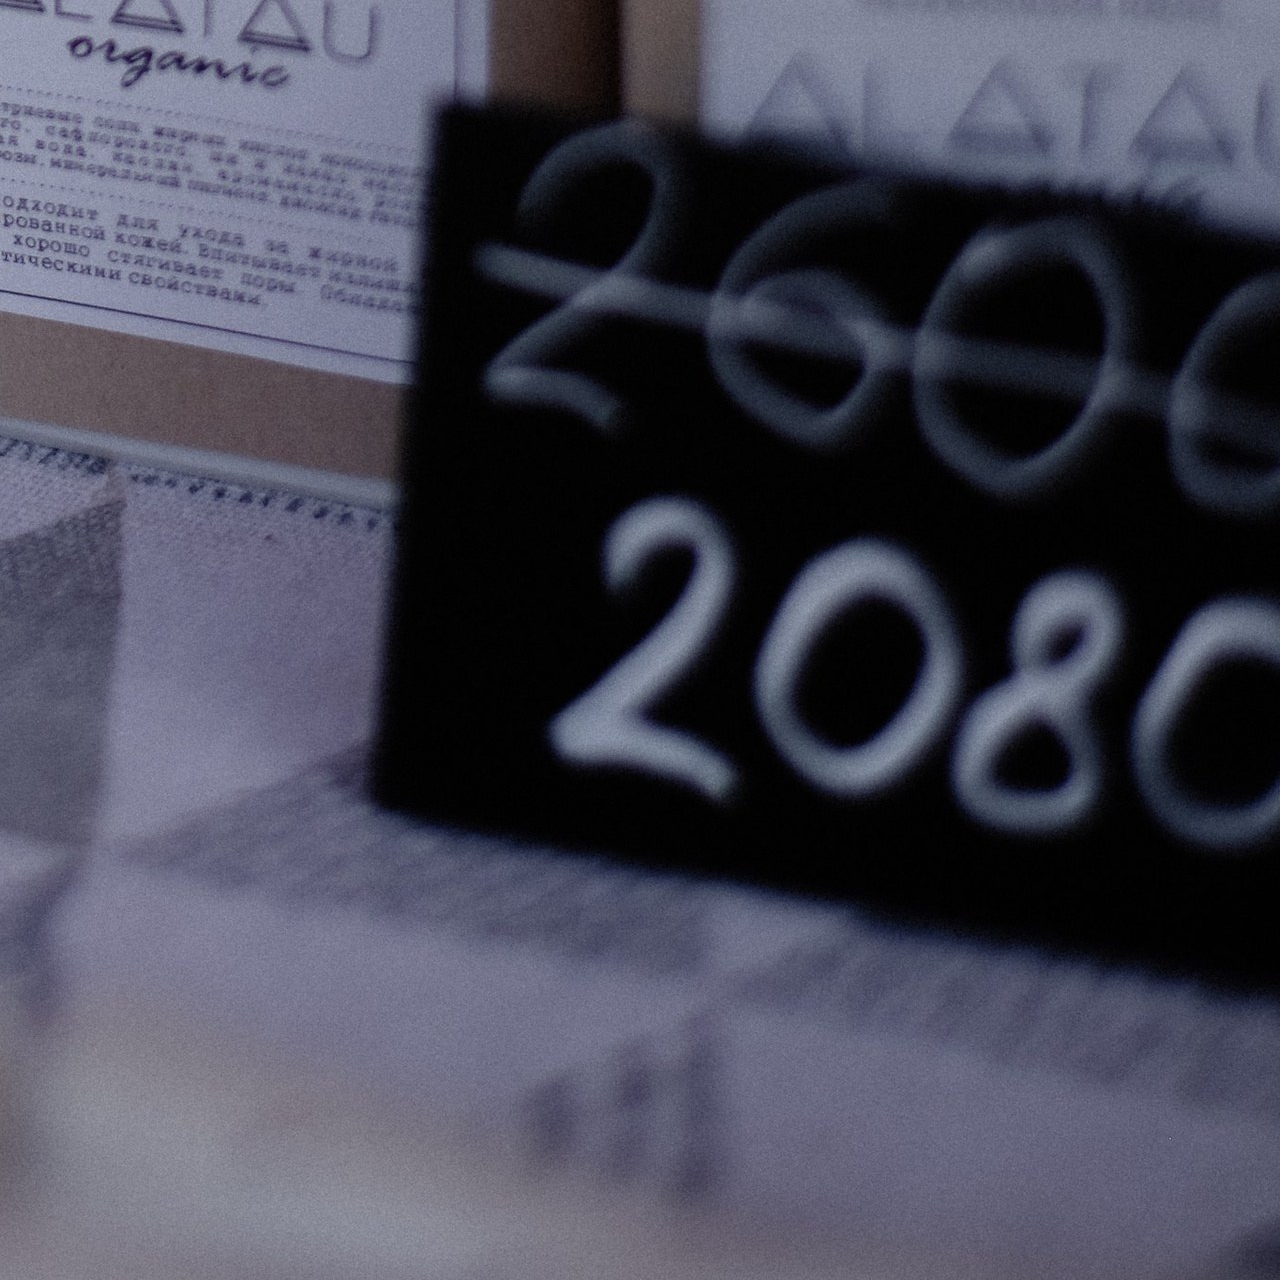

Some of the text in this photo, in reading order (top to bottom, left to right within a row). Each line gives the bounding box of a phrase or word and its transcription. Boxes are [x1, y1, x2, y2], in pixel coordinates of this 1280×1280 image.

[66, 35, 291, 89] organic
[116, 213, 160, 232] для
[12, 232, 91, 258] хорошо
[106, 248, 225, 280] стягивает
[546, 493, 1280, 847] 2080
